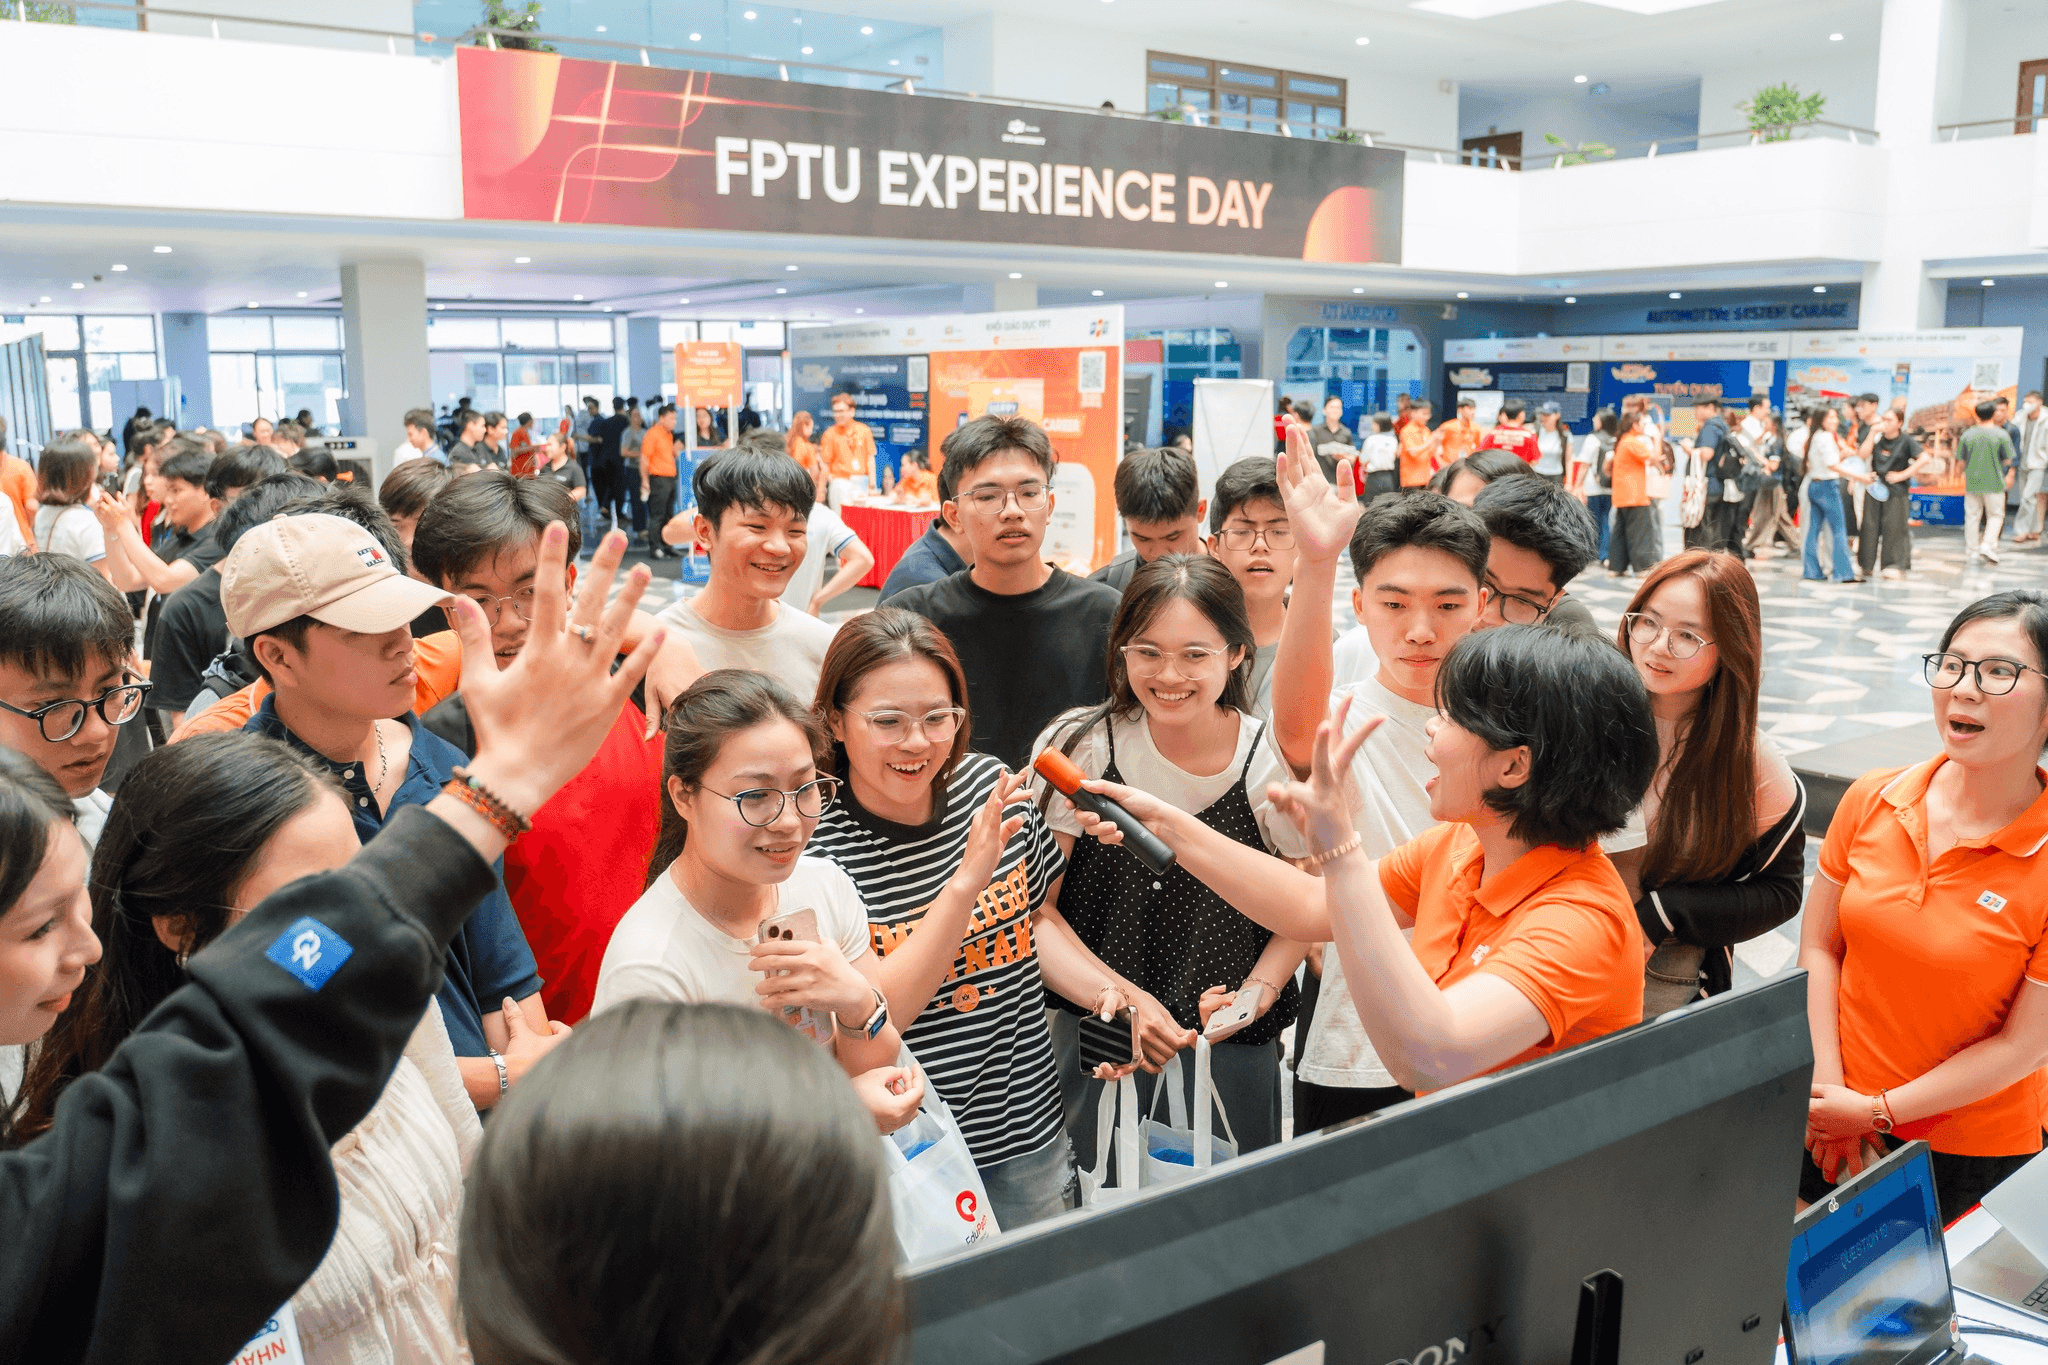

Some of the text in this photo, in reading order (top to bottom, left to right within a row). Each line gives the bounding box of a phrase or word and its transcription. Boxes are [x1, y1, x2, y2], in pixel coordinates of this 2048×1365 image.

[715, 135, 1274, 230] FPTU EXPERIENCE DAY
